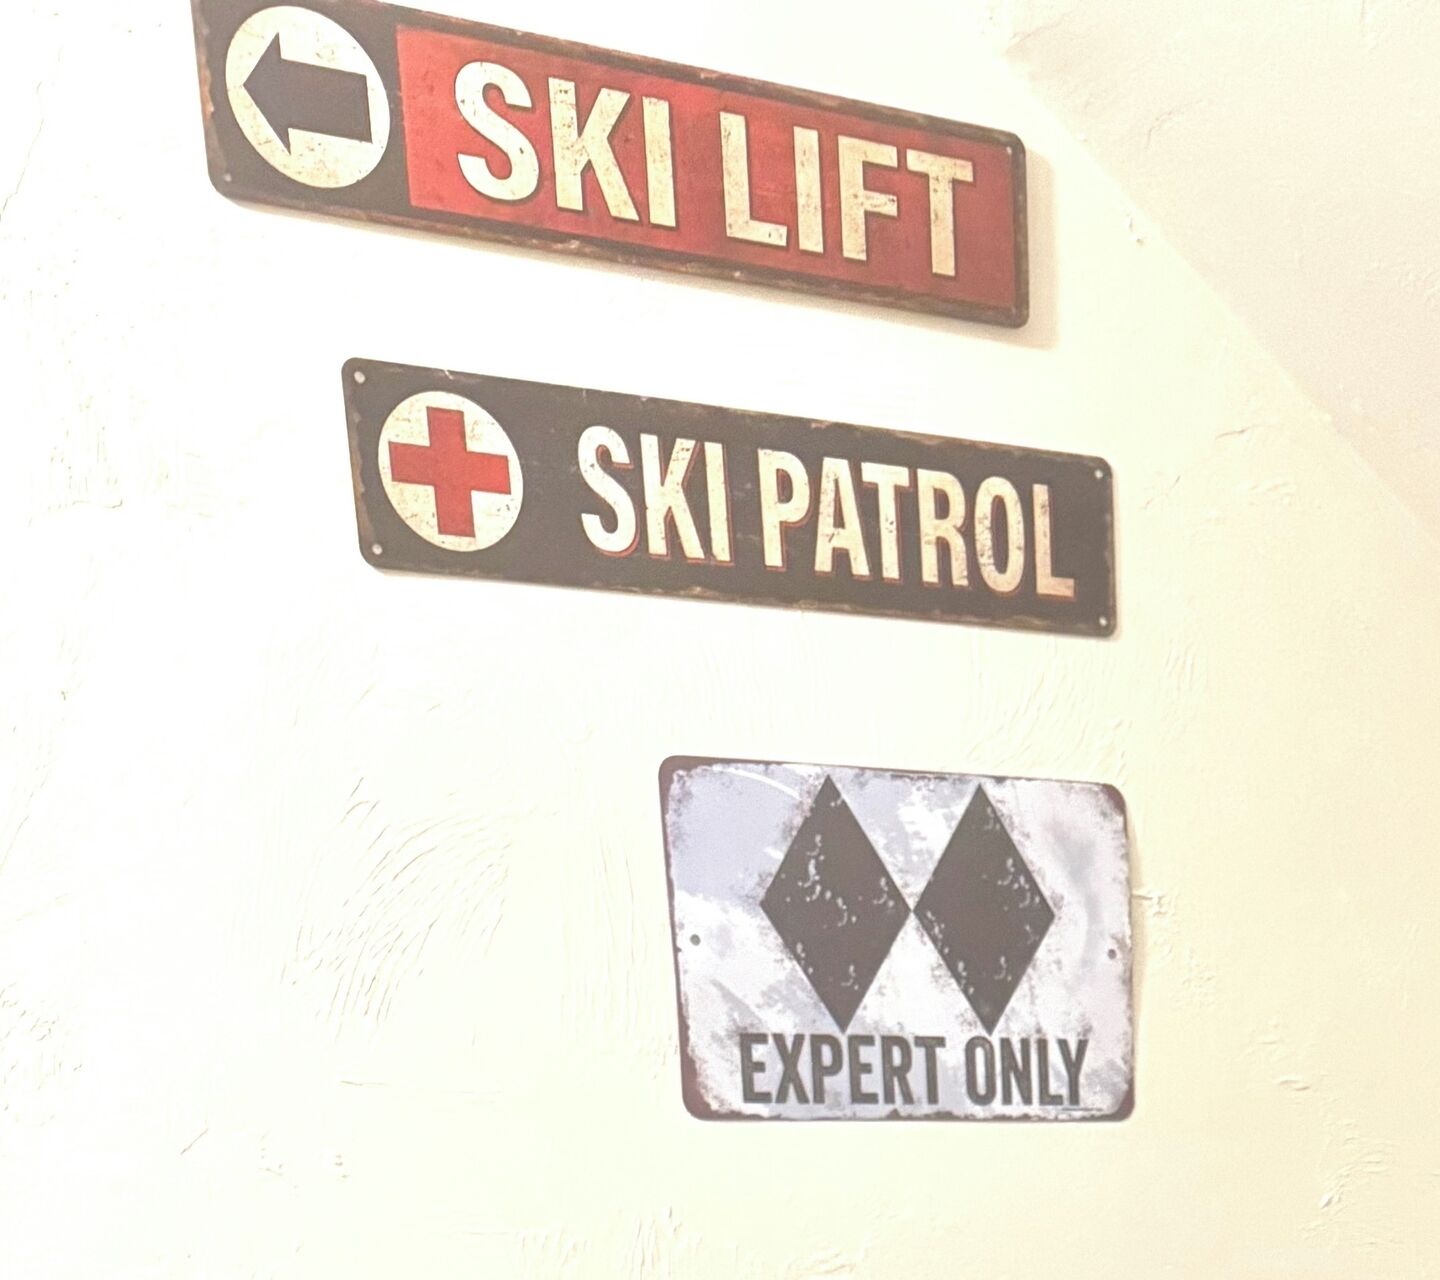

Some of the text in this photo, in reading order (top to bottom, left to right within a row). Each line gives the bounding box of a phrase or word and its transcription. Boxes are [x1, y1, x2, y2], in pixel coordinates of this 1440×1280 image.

[453, 60, 973, 280] SKI LIFT
[577, 424, 1077, 598] SKI PATROL
[739, 1032, 1089, 1106] EXPERT ONLY
